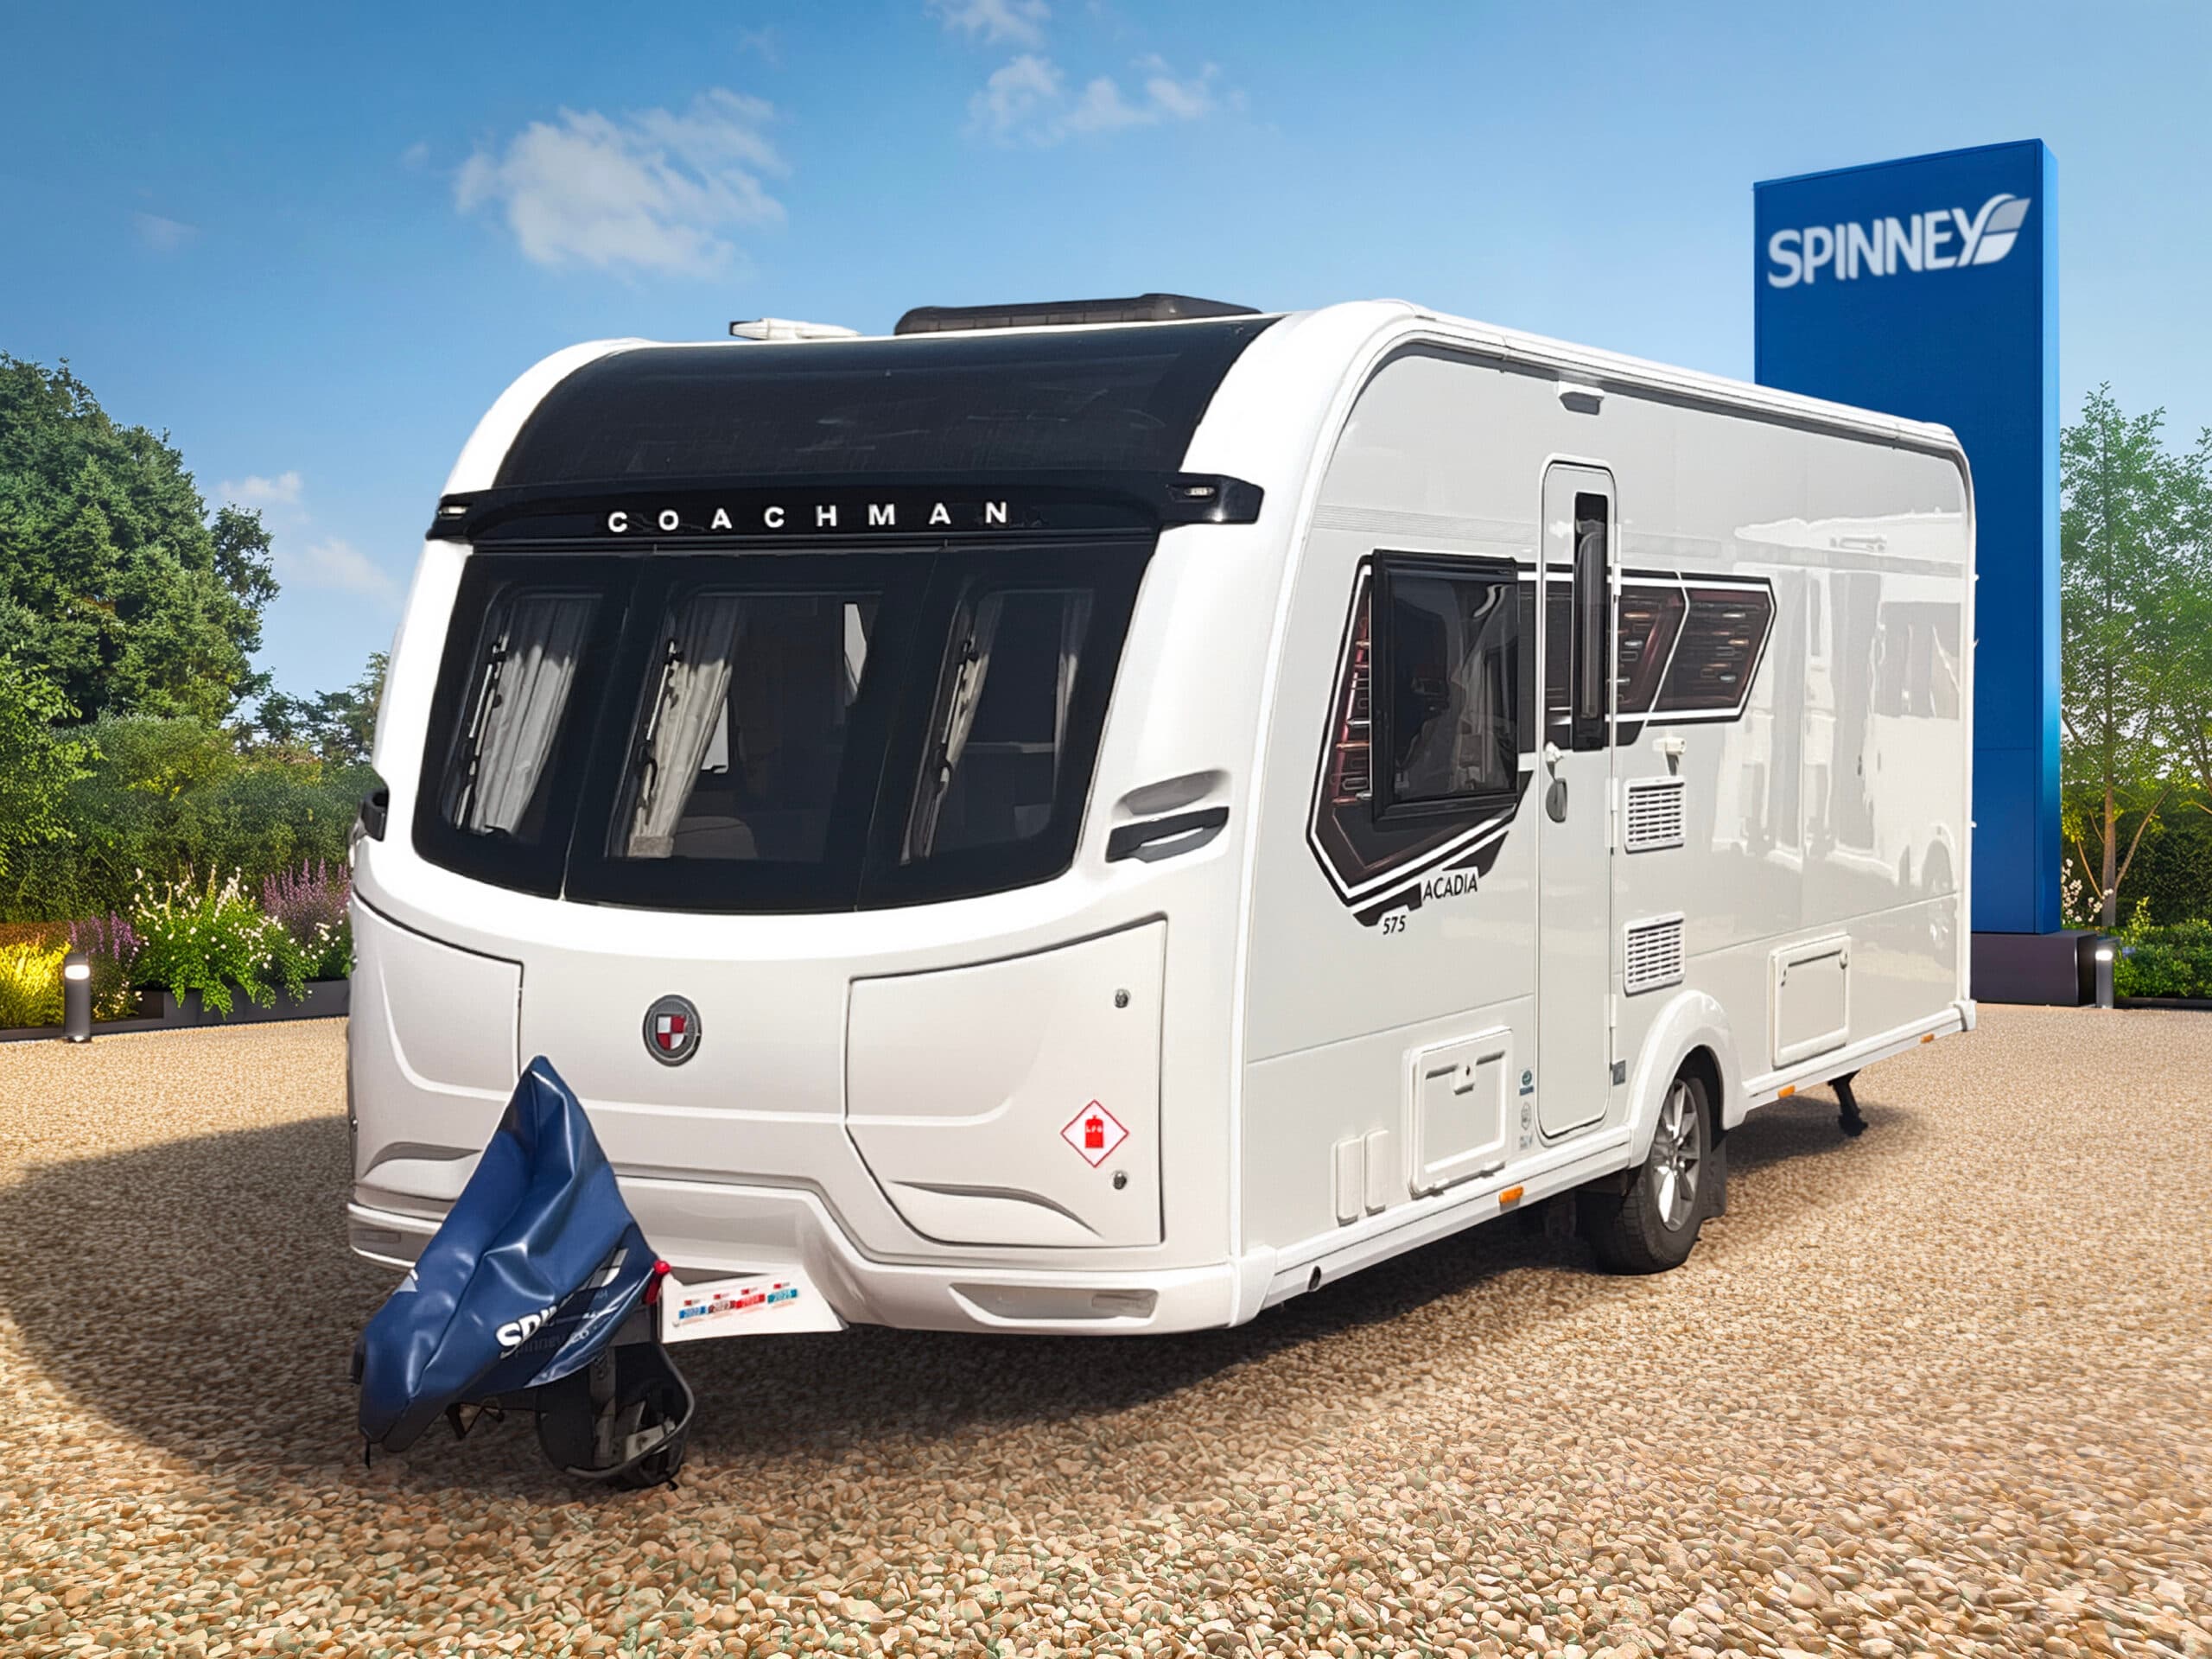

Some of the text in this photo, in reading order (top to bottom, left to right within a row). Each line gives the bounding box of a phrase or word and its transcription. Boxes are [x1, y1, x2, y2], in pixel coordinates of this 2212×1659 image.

[1768, 194, 2017, 288] SPINNEY
[607, 501, 1007, 532] COACHMAN
[1422, 873, 1478, 900] ACADIA
[1382, 914, 1406, 935] 575
